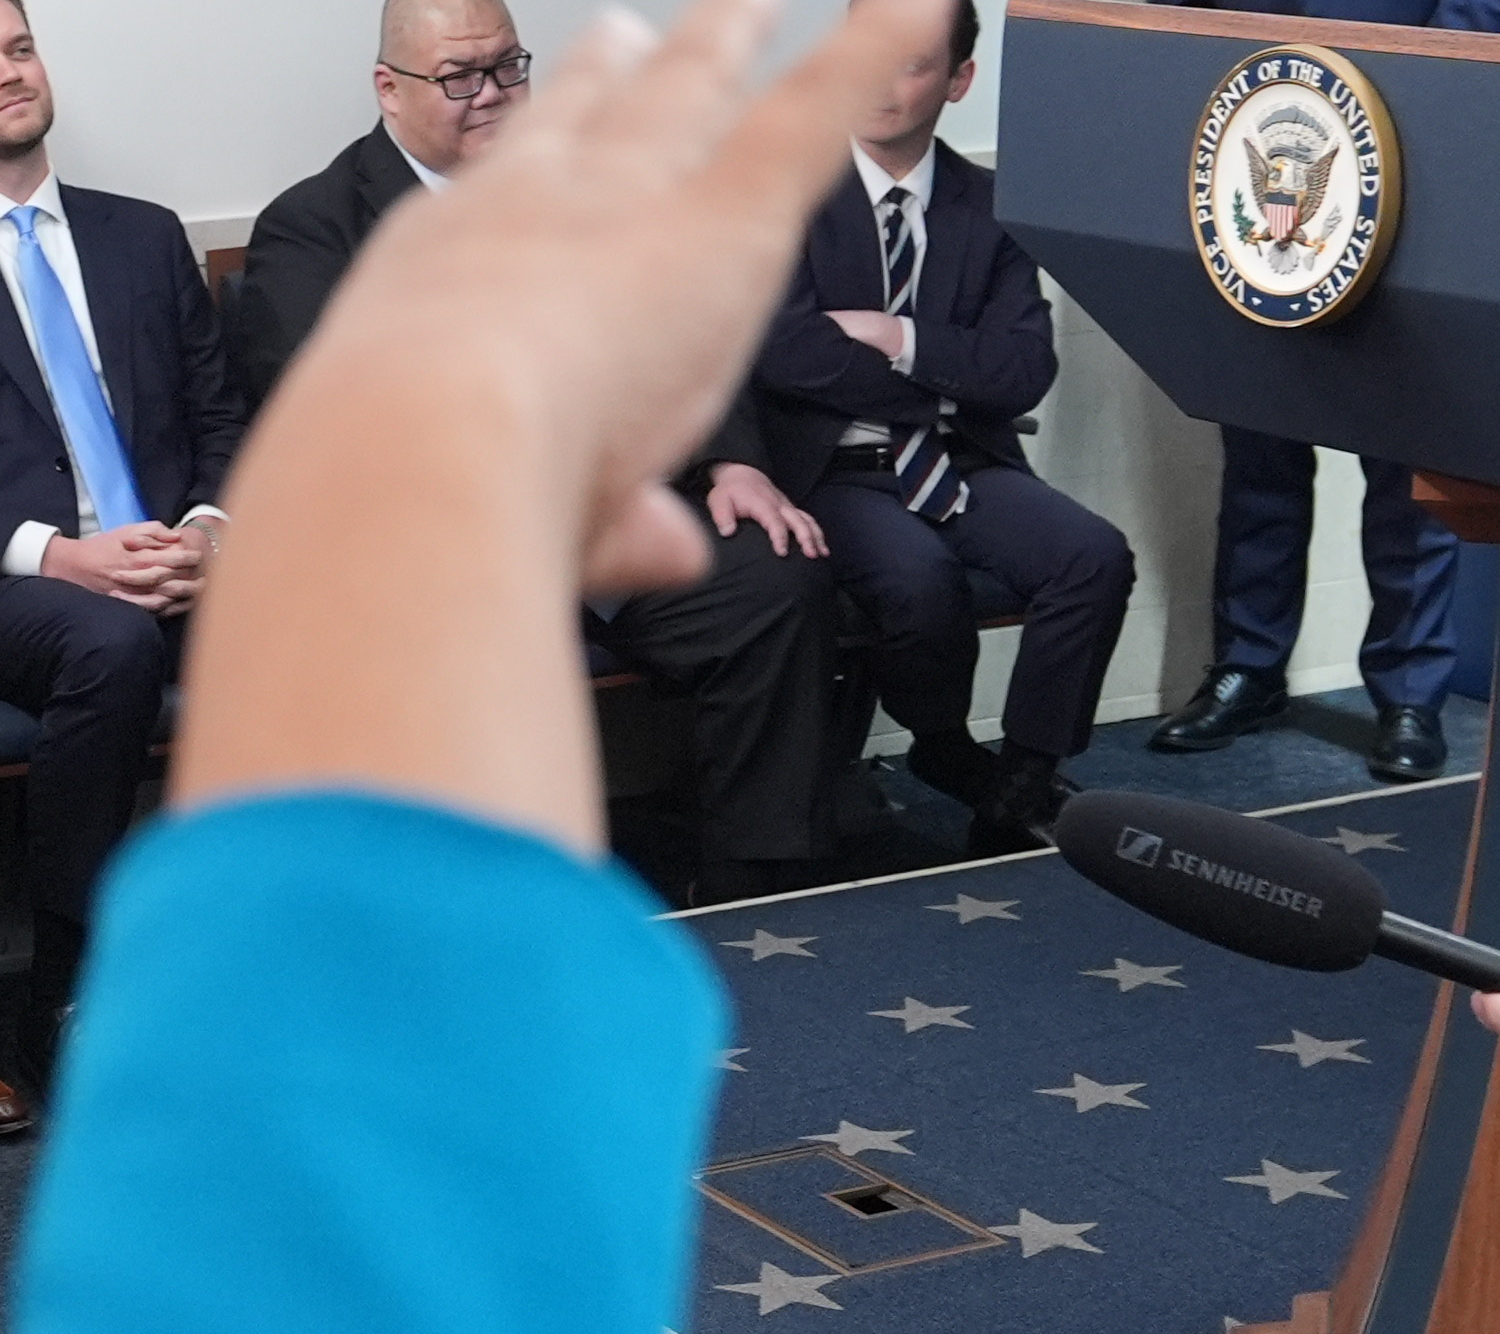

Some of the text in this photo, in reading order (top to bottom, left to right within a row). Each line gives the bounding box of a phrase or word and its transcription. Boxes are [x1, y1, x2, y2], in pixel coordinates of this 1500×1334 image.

[1194, 59, 1381, 313] VICE PRESIDENT OF THE UNITED STATES
[1168, 849, 1324, 919] SENNHEISER
